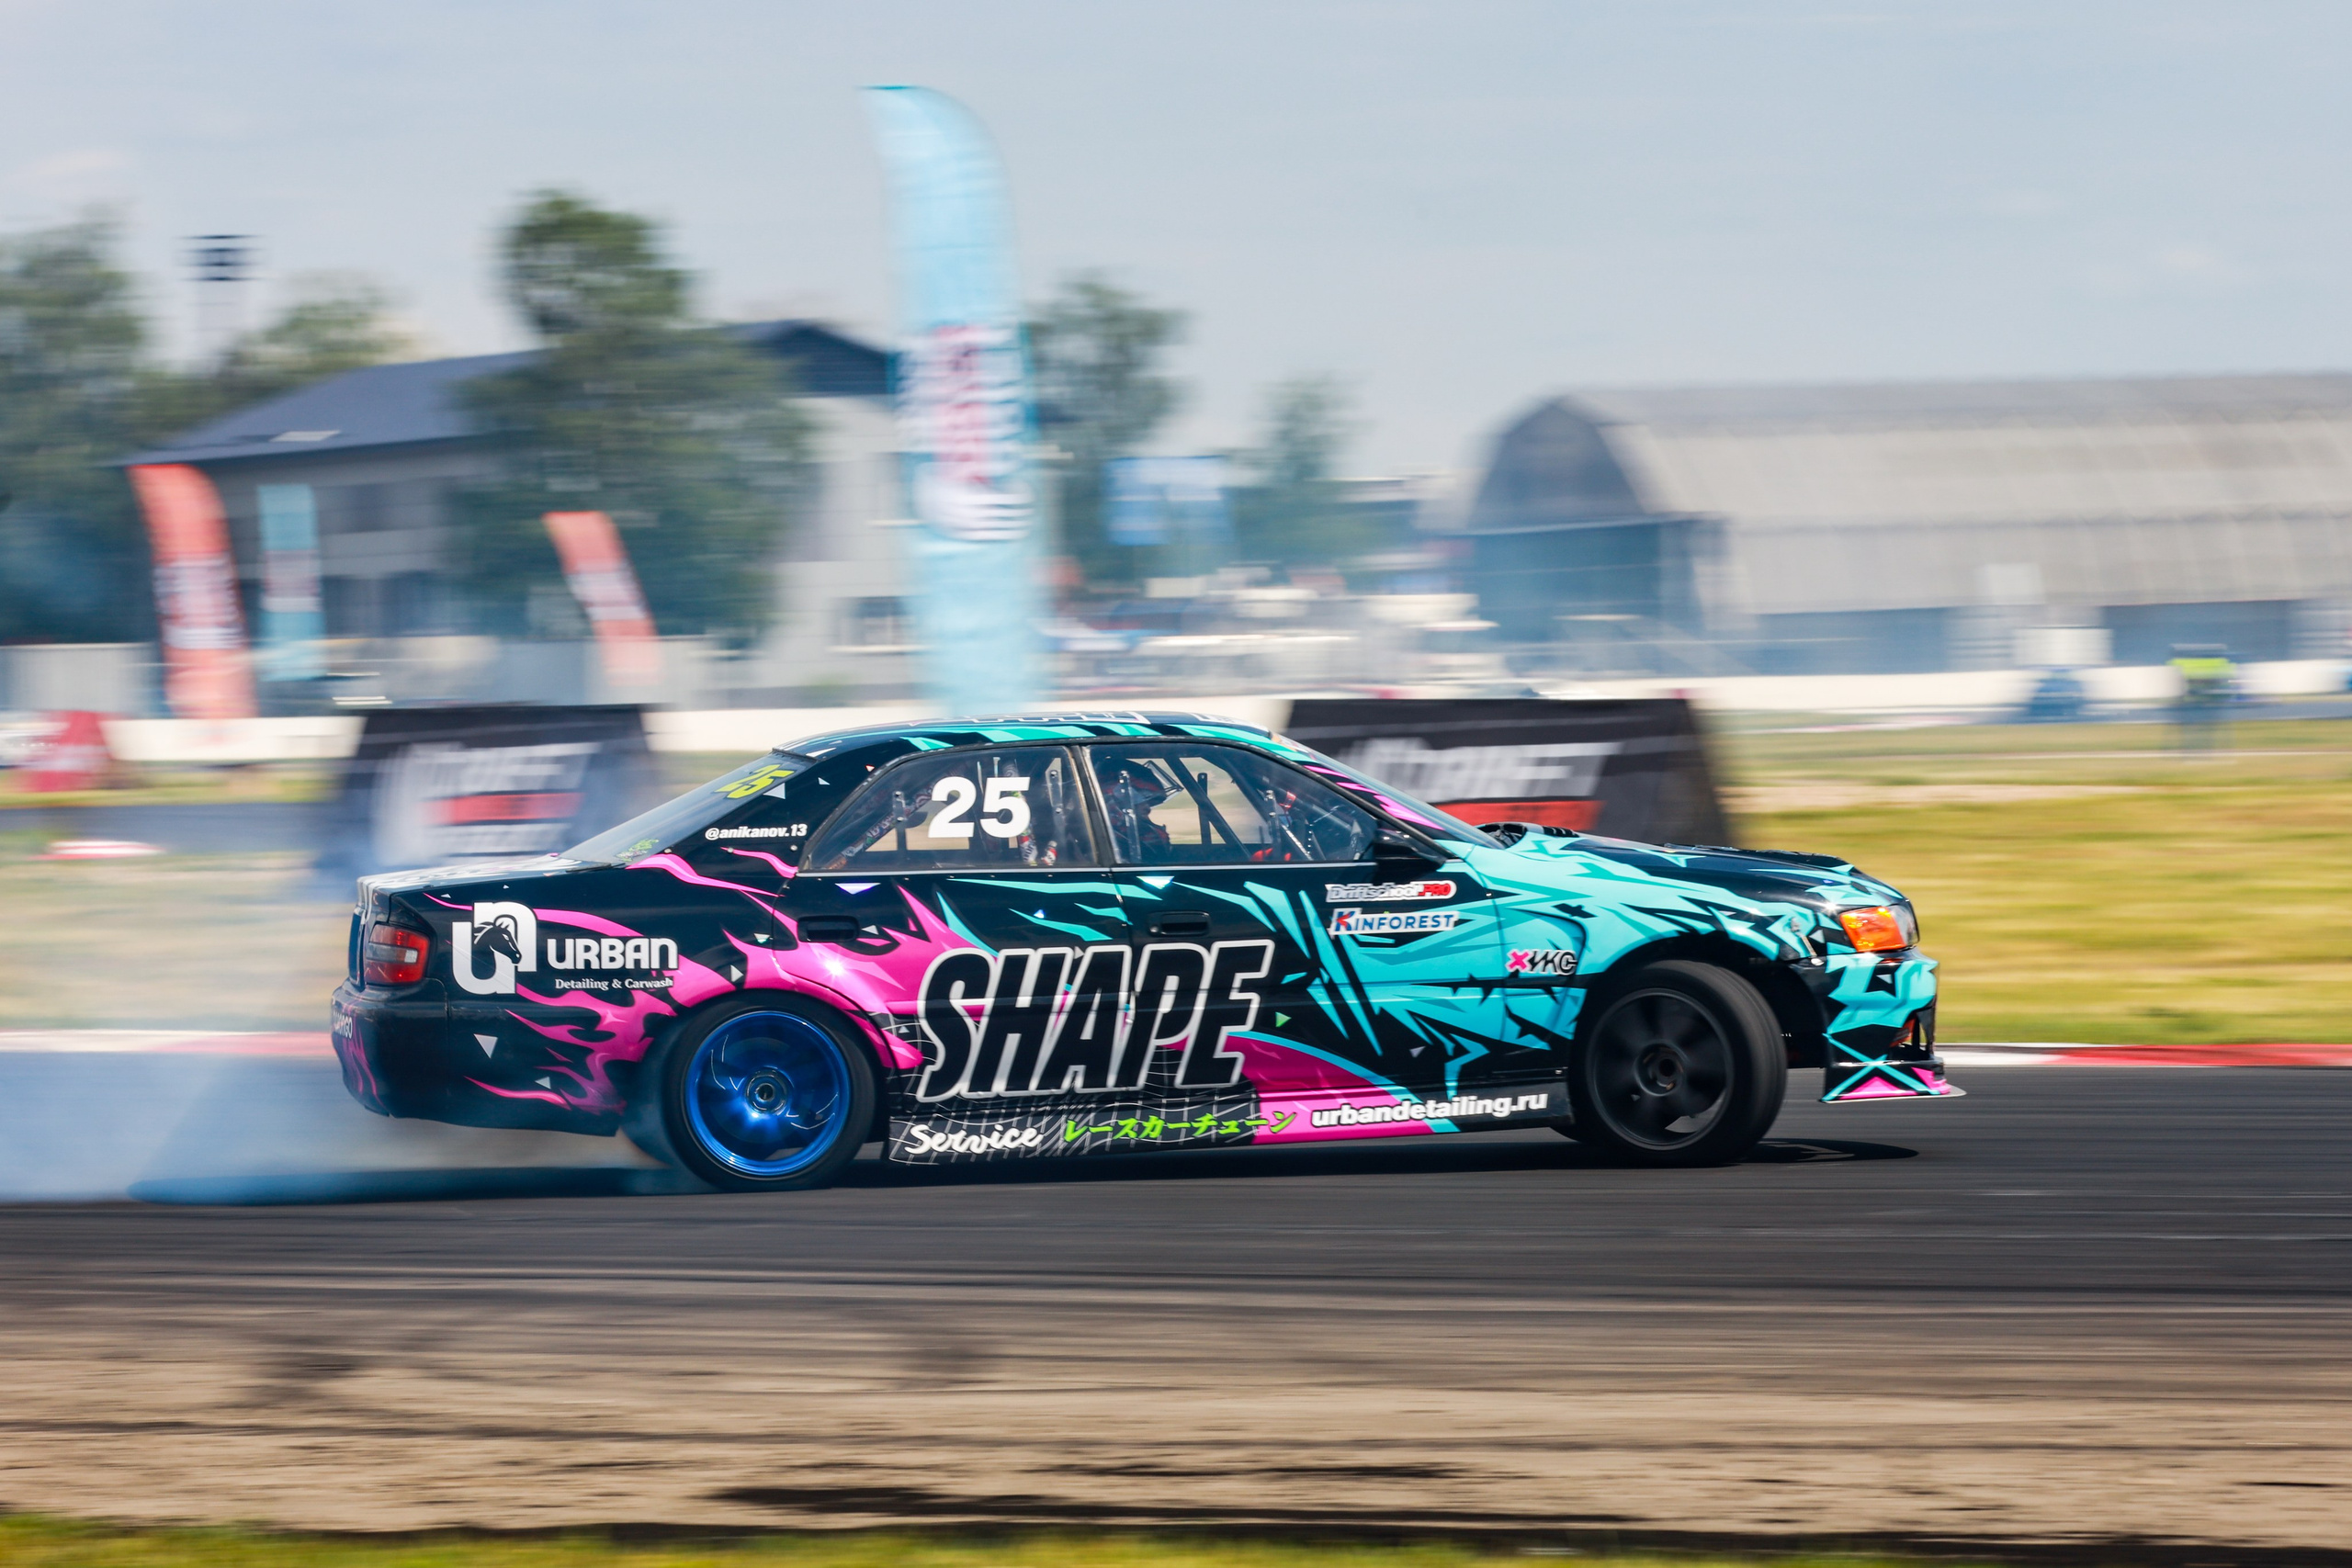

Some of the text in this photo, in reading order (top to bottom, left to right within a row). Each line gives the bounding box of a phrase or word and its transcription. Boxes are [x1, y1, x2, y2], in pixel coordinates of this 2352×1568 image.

[713, 764, 795, 799] 25
[928, 776, 1031, 838] 25
[705, 824, 808, 840] @anikanov.13
[1335, 910, 1455, 931] KINFOREST
[555, 977, 673, 991] Detailing & Carwash
[917, 939, 1275, 1102] SHAPE
[1064, 1111, 1297, 1142] レースカーチューン
[1311, 1093, 1548, 1127] urbandetailing.ru
[905, 1123, 1044, 1156] Service
